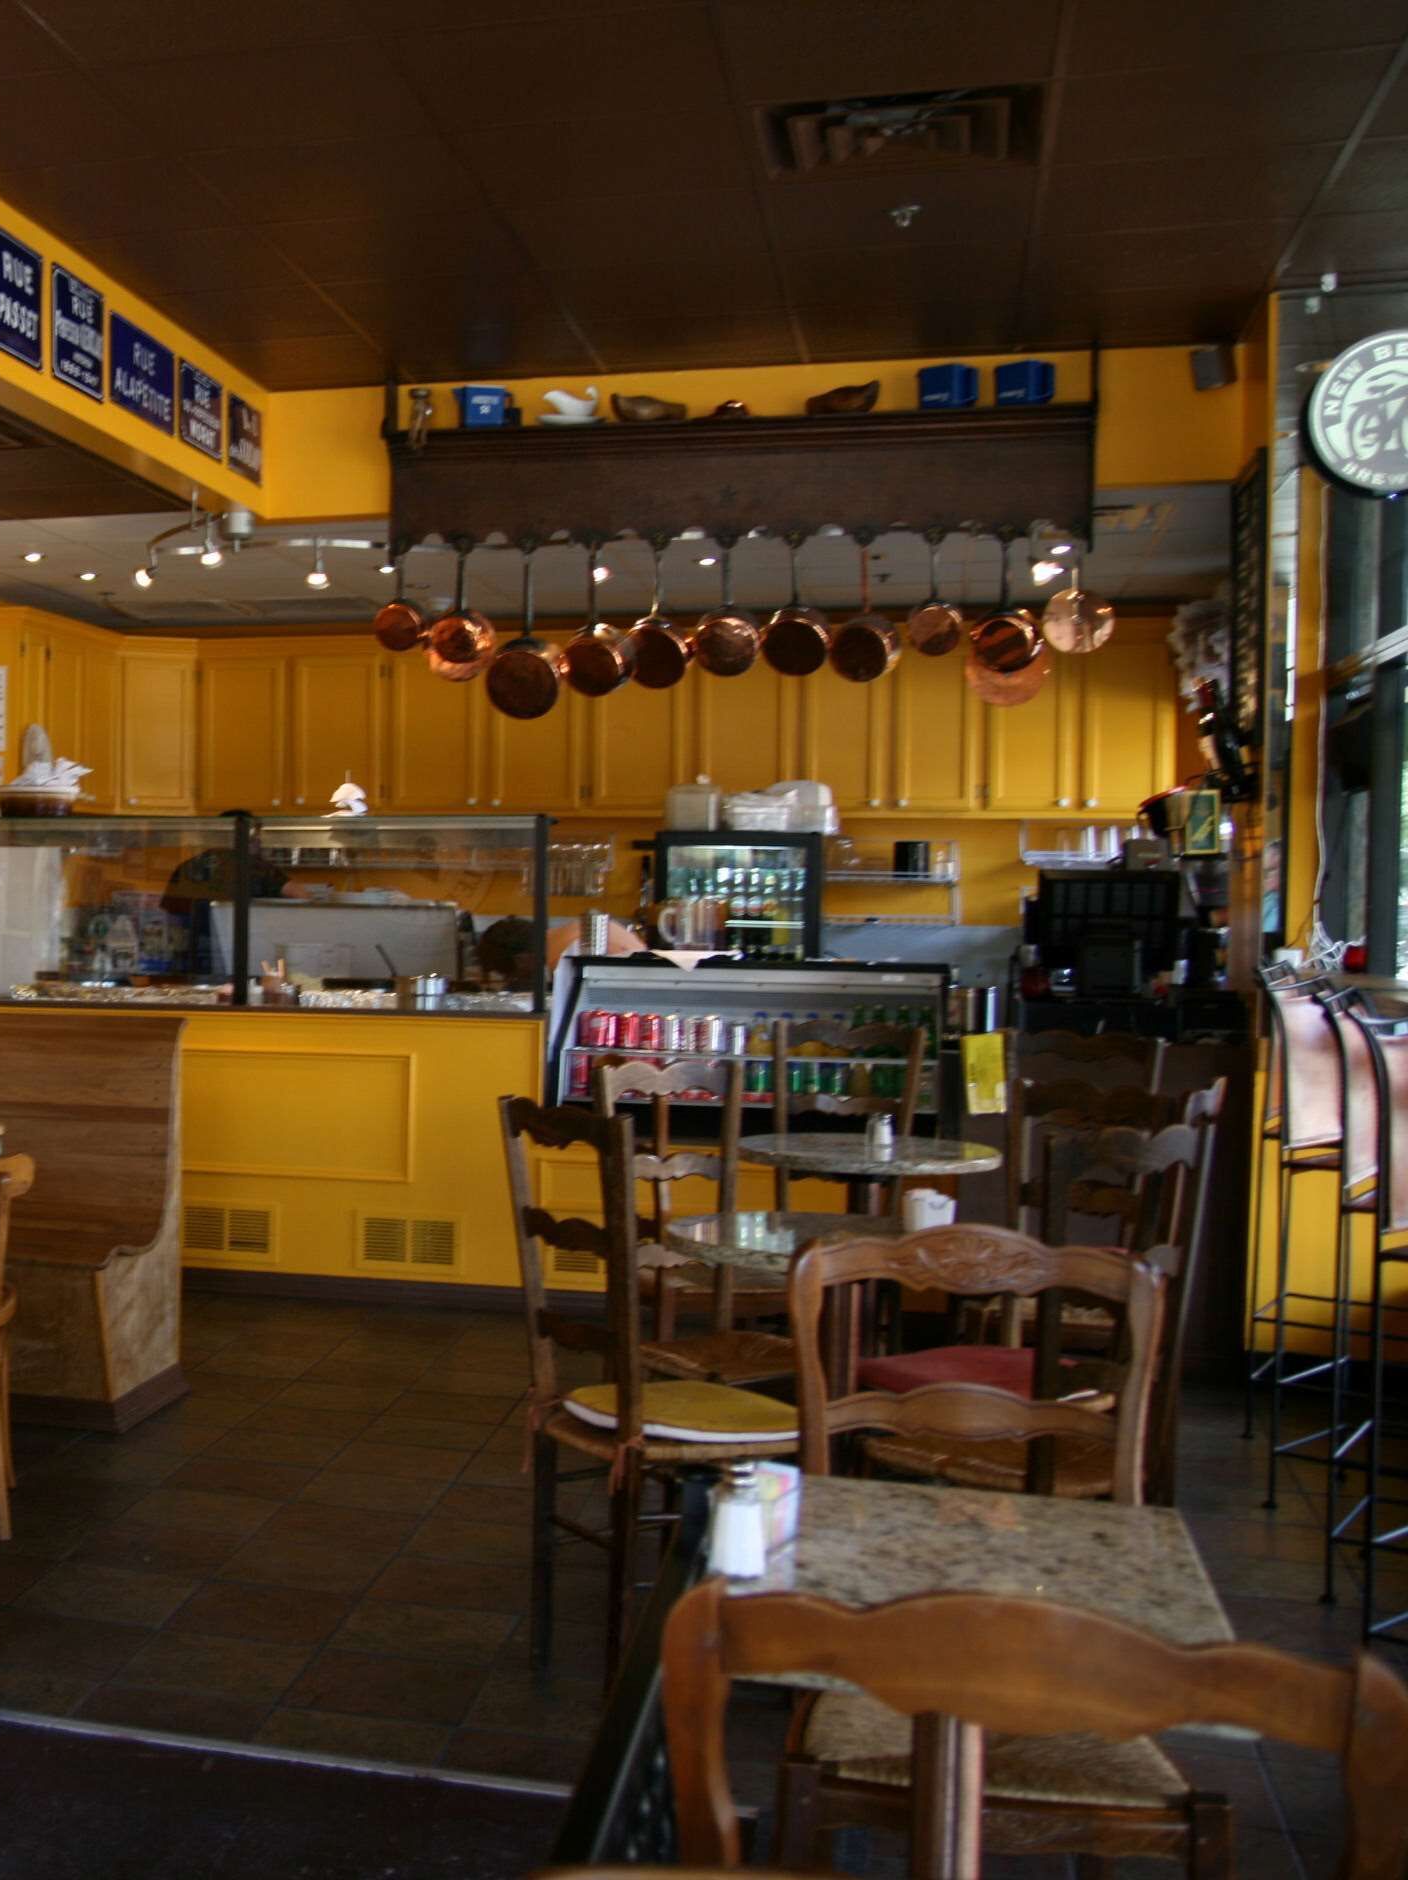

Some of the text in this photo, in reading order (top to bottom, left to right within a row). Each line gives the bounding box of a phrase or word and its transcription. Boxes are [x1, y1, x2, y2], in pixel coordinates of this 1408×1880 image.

[2, 251, 34, 296] RUE
[71, 296, 95, 324] RUE
[133, 342, 156, 376] RUE
[114, 367, 171, 422] ALAPETITE
[1323, 359, 1363, 415] NEW
